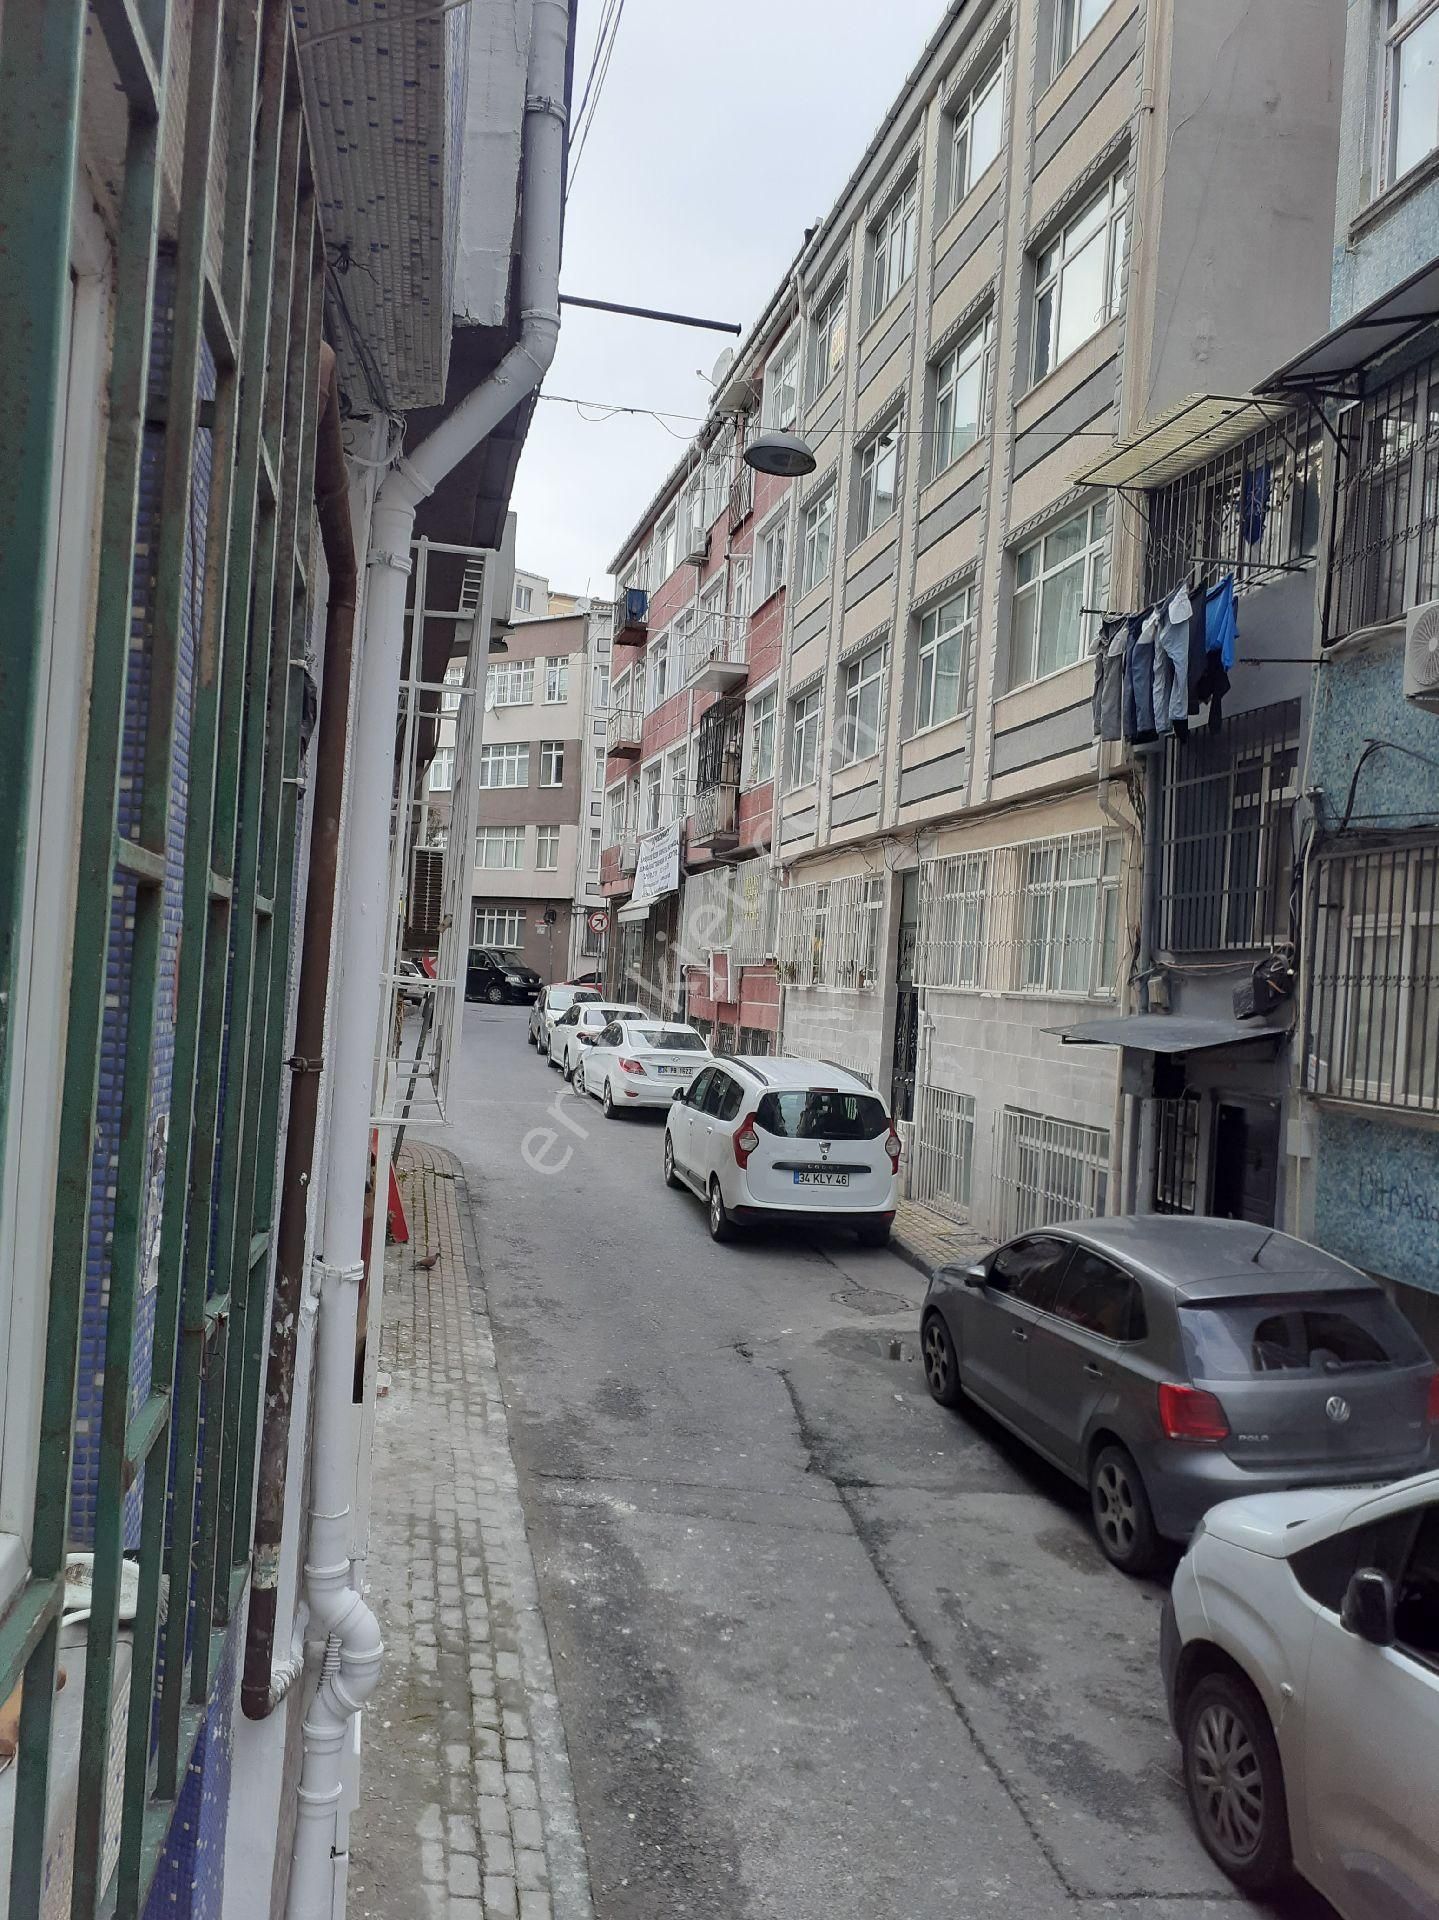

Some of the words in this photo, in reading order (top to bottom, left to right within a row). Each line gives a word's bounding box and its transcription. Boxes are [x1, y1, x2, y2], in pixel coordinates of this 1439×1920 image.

[799, 1173, 810, 1183] 34
[813, 1173, 833, 1184] KLY
[836, 1174, 847, 1185] 46
[1238, 1434, 1269, 1442] POLO
